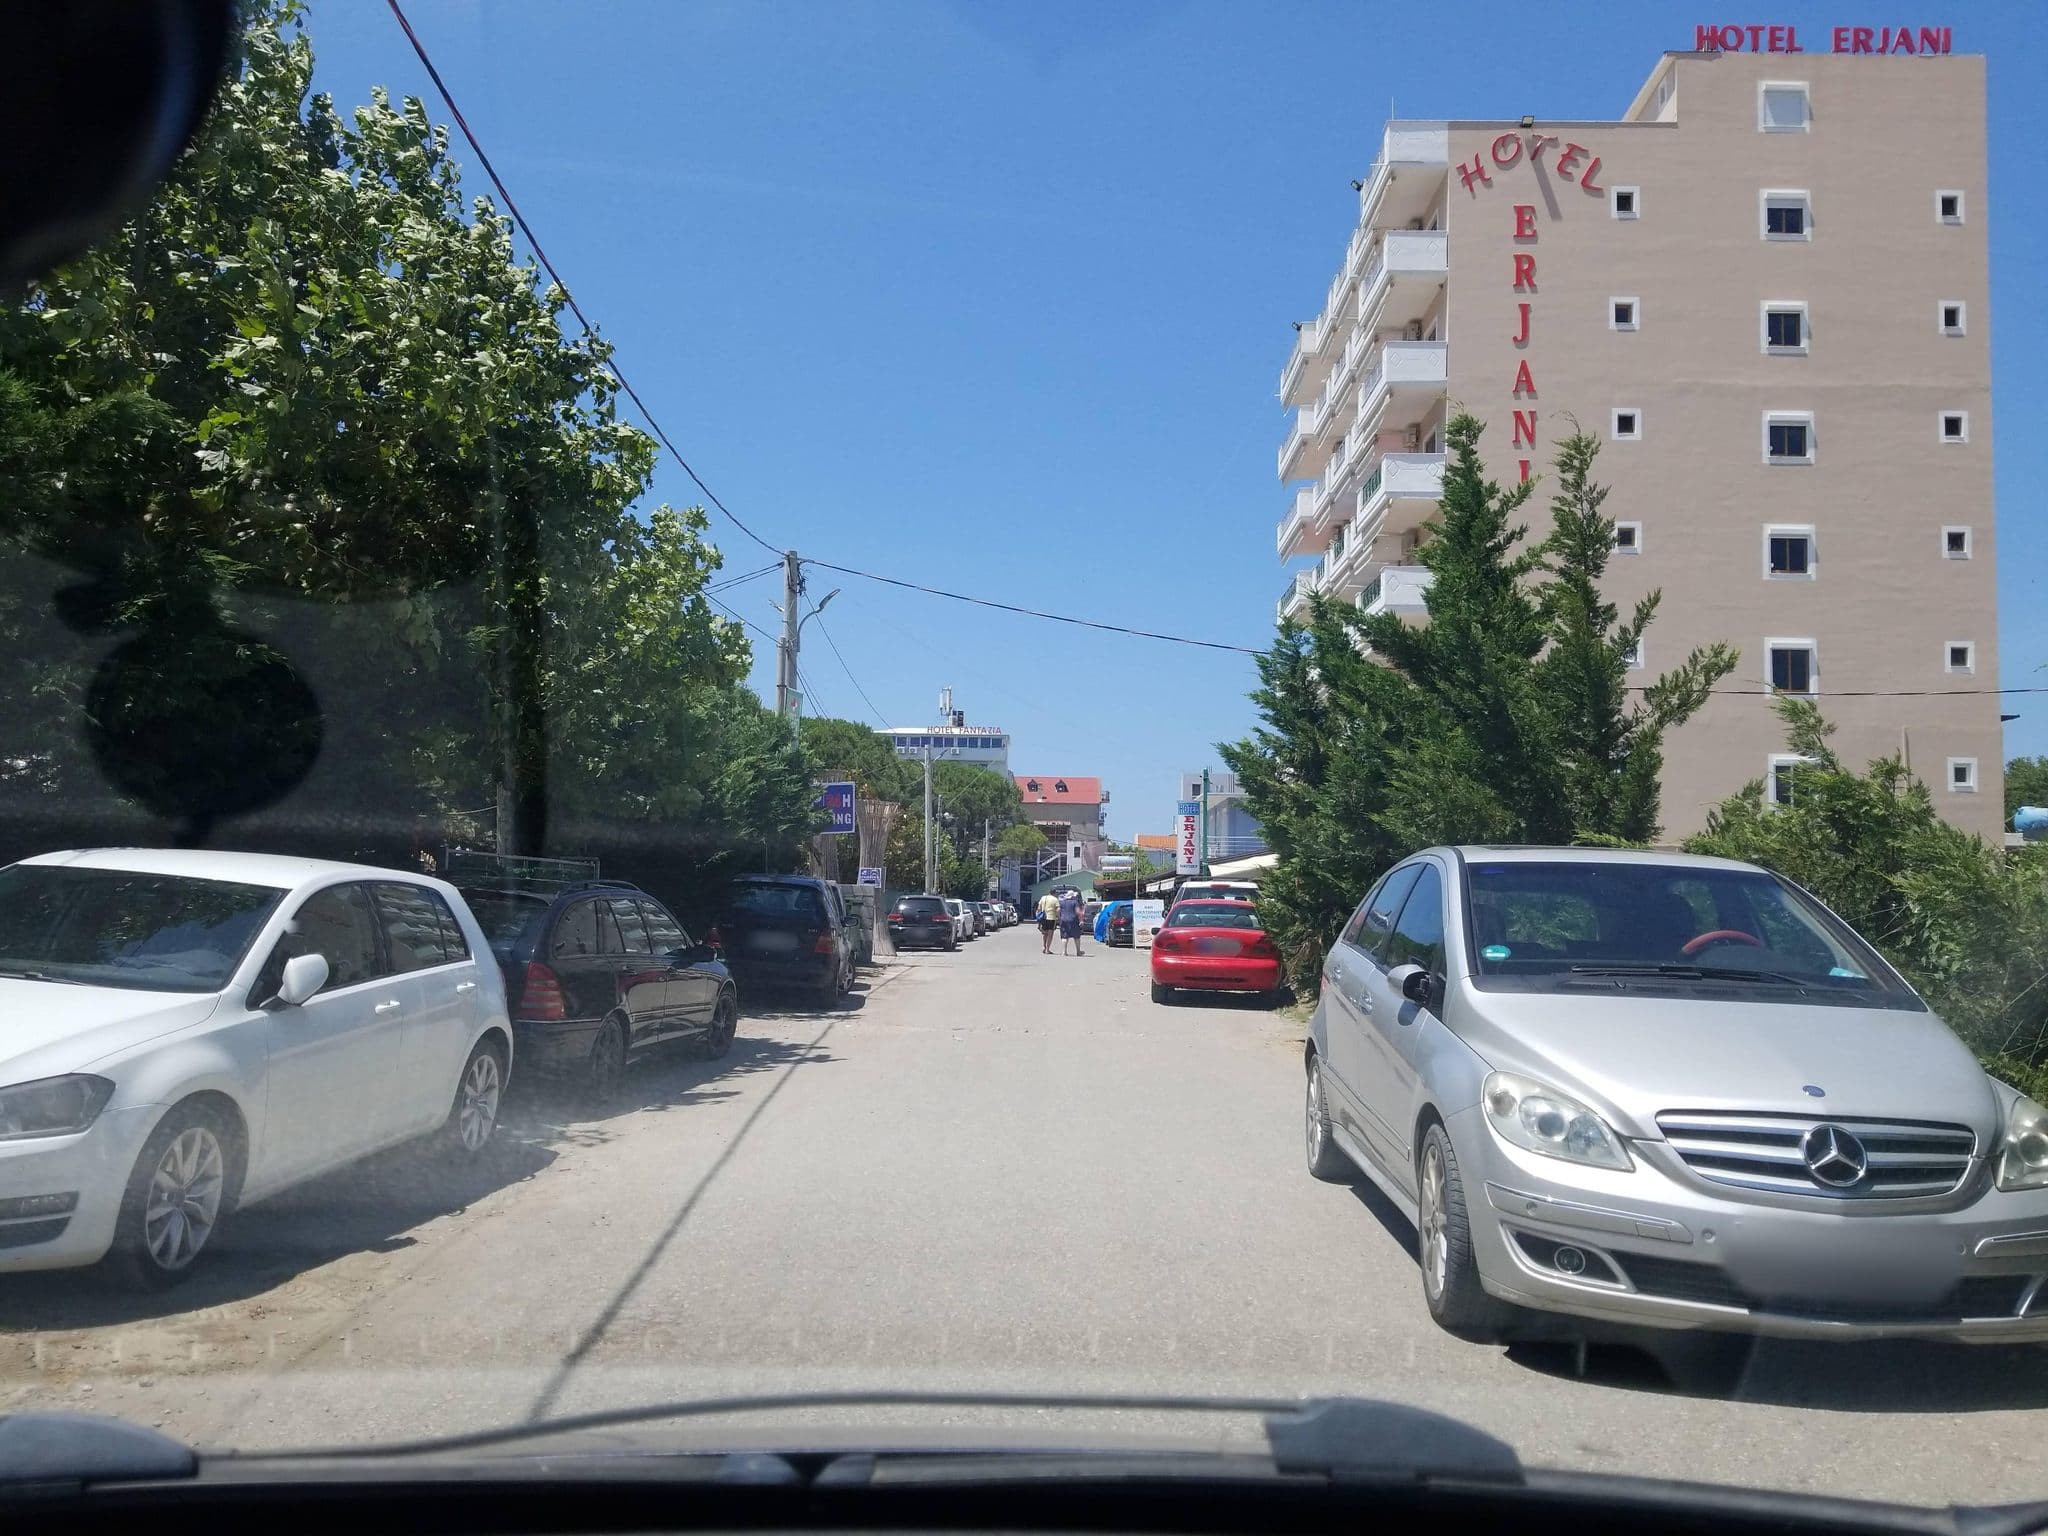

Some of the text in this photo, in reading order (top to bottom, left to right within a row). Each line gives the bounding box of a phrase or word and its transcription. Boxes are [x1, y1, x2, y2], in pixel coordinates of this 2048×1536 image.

[1695, 24, 1953, 55] HOTEL ERJANI
[1455, 131, 1604, 193] HOTEL
[1512, 204, 1538, 485] ERJANI
[927, 725, 955, 734] HOTEL
[1179, 803, 1199, 815] HOTEL
[1183, 815, 1196, 865] ERJANI
